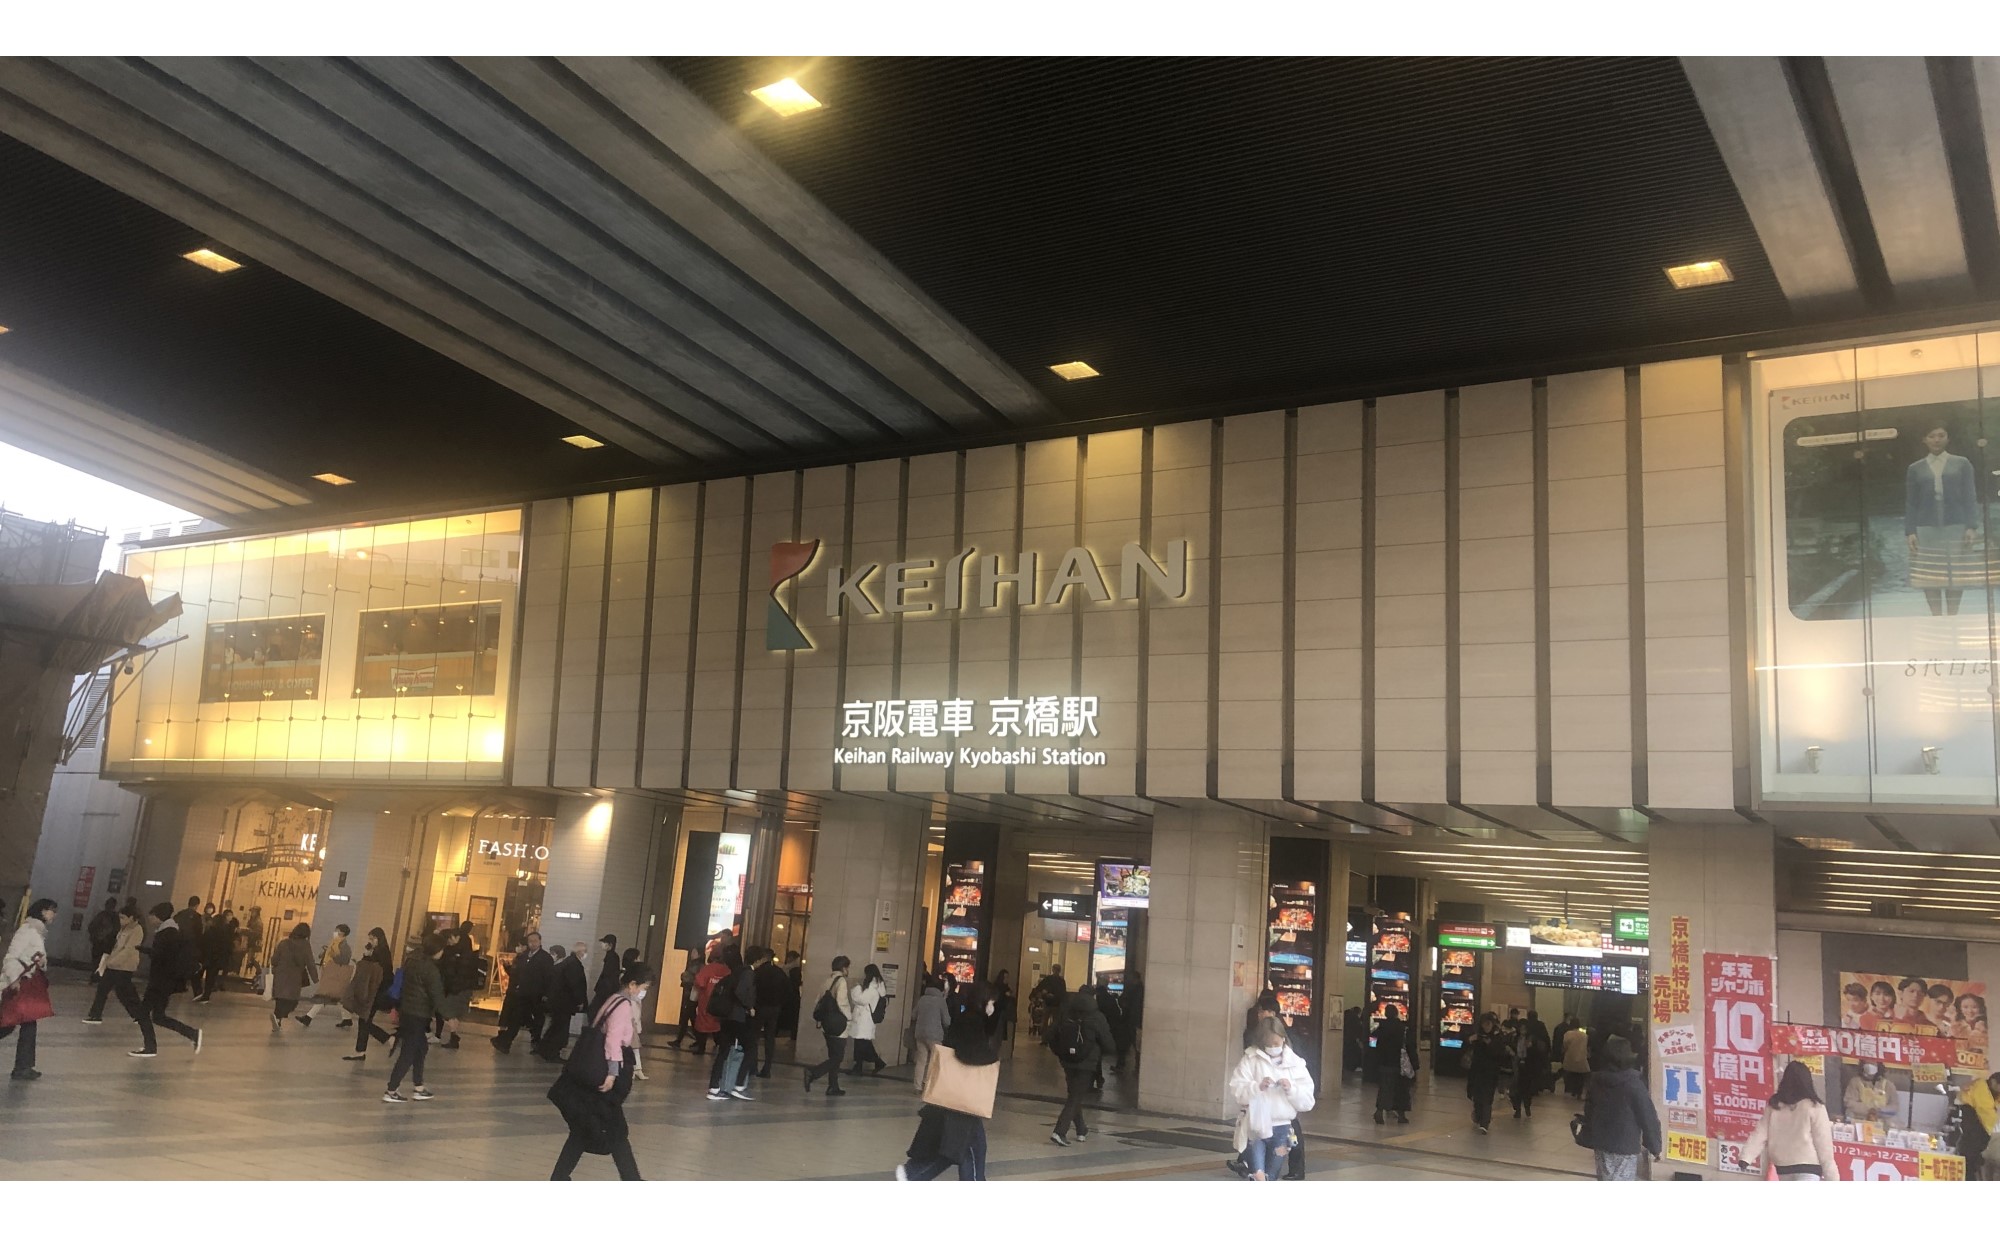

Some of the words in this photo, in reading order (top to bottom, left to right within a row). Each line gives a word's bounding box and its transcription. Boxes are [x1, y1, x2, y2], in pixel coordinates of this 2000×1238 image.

[827, 539, 1187, 617] KEIHAN
[841, 697, 974, 738] 京阪電車
[988, 695, 1098, 737] 京橋駅
[834, 747, 886, 764] Keihan
[891, 746, 954, 768] Railway
[960, 746, 1036, 768] Kyobashi
[1042, 747, 1106, 766] Station
[478, 839, 549, 861] FASHO
[259, 880, 306, 899] KEIHAN
[1671, 915, 1690, 1013] 京橋特設
[1721, 961, 1753, 979] 年末
[1653, 974, 1672, 1024] 売場
[1711, 977, 1764, 996] ジャンボ
[1712, 999, 1764, 1054] 10
[1829, 1029, 1902, 1062] 10億円
[1713, 1052, 1765, 1084] 億円
[1731, 1083, 1748, 1097] ミニ
[1720, 1144, 1728, 1164] あと
